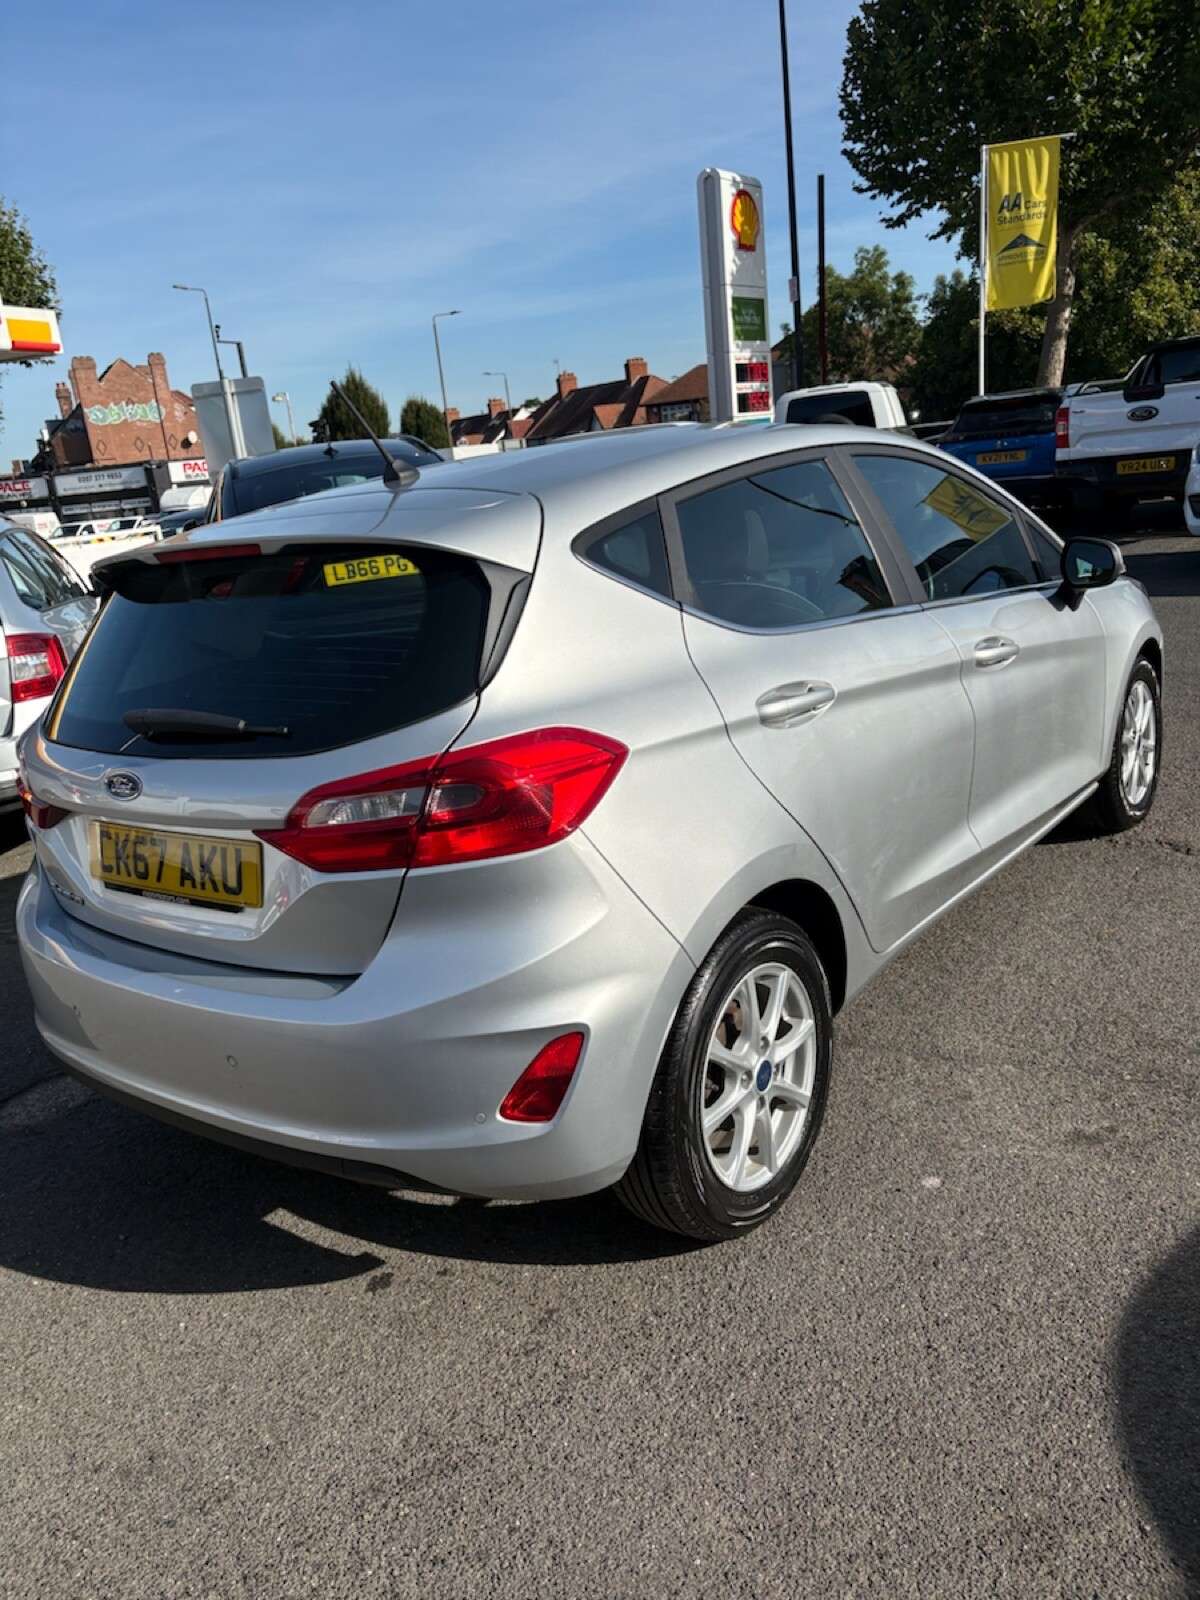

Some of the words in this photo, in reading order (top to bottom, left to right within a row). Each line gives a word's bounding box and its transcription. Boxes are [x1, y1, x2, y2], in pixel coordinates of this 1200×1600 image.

[998, 192, 1022, 214] AA
[332, 559, 380, 580] LB66
[100, 828, 167, 883] CK67
[179, 841, 243, 896] AKU
